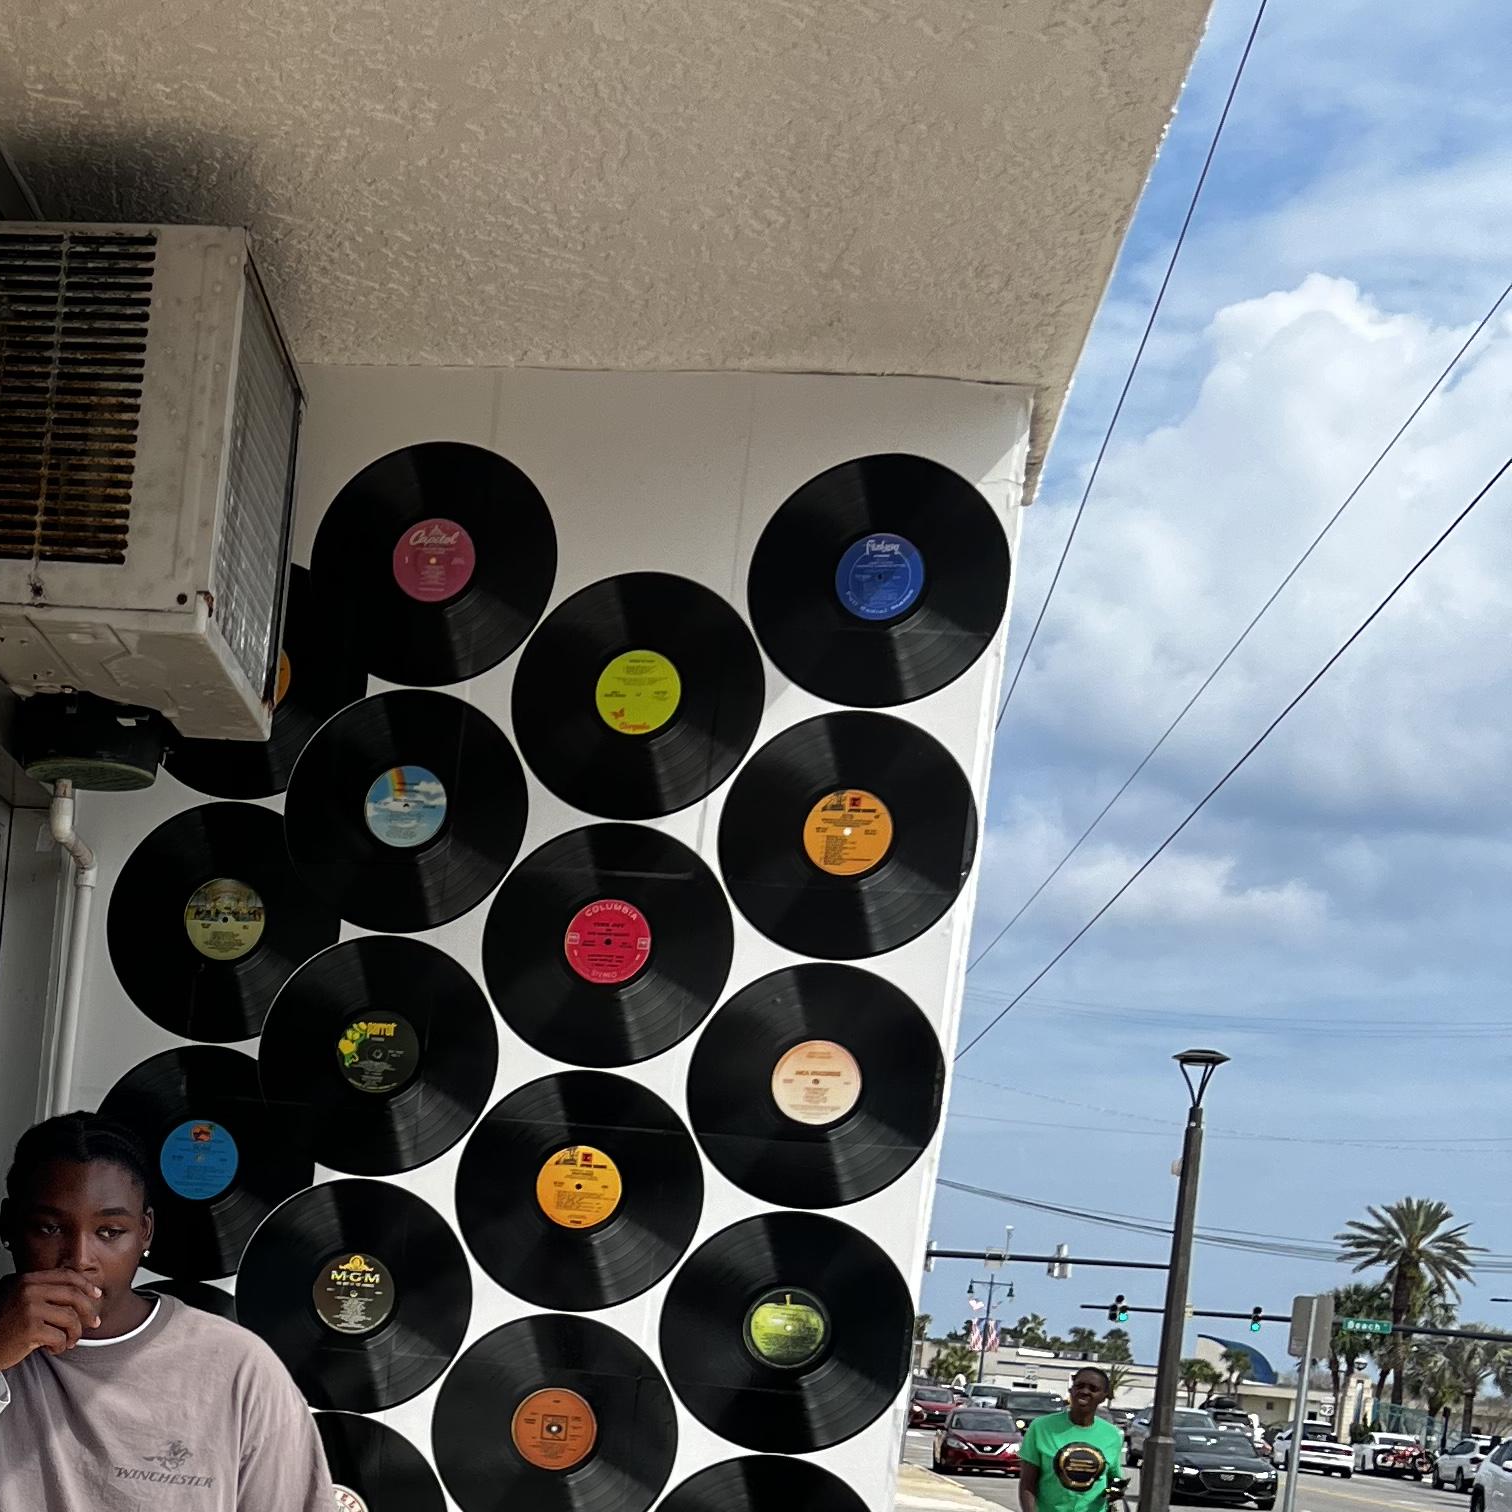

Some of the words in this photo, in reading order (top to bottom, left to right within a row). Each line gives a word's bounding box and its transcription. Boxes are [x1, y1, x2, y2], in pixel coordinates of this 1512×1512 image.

[409, 529, 460, 546] Capitol
[584, 903, 638, 921] COLUMBIA
[1347, 1320, 1381, 1331] Beach
[113, 1466, 216, 1488] WINCHESTER
